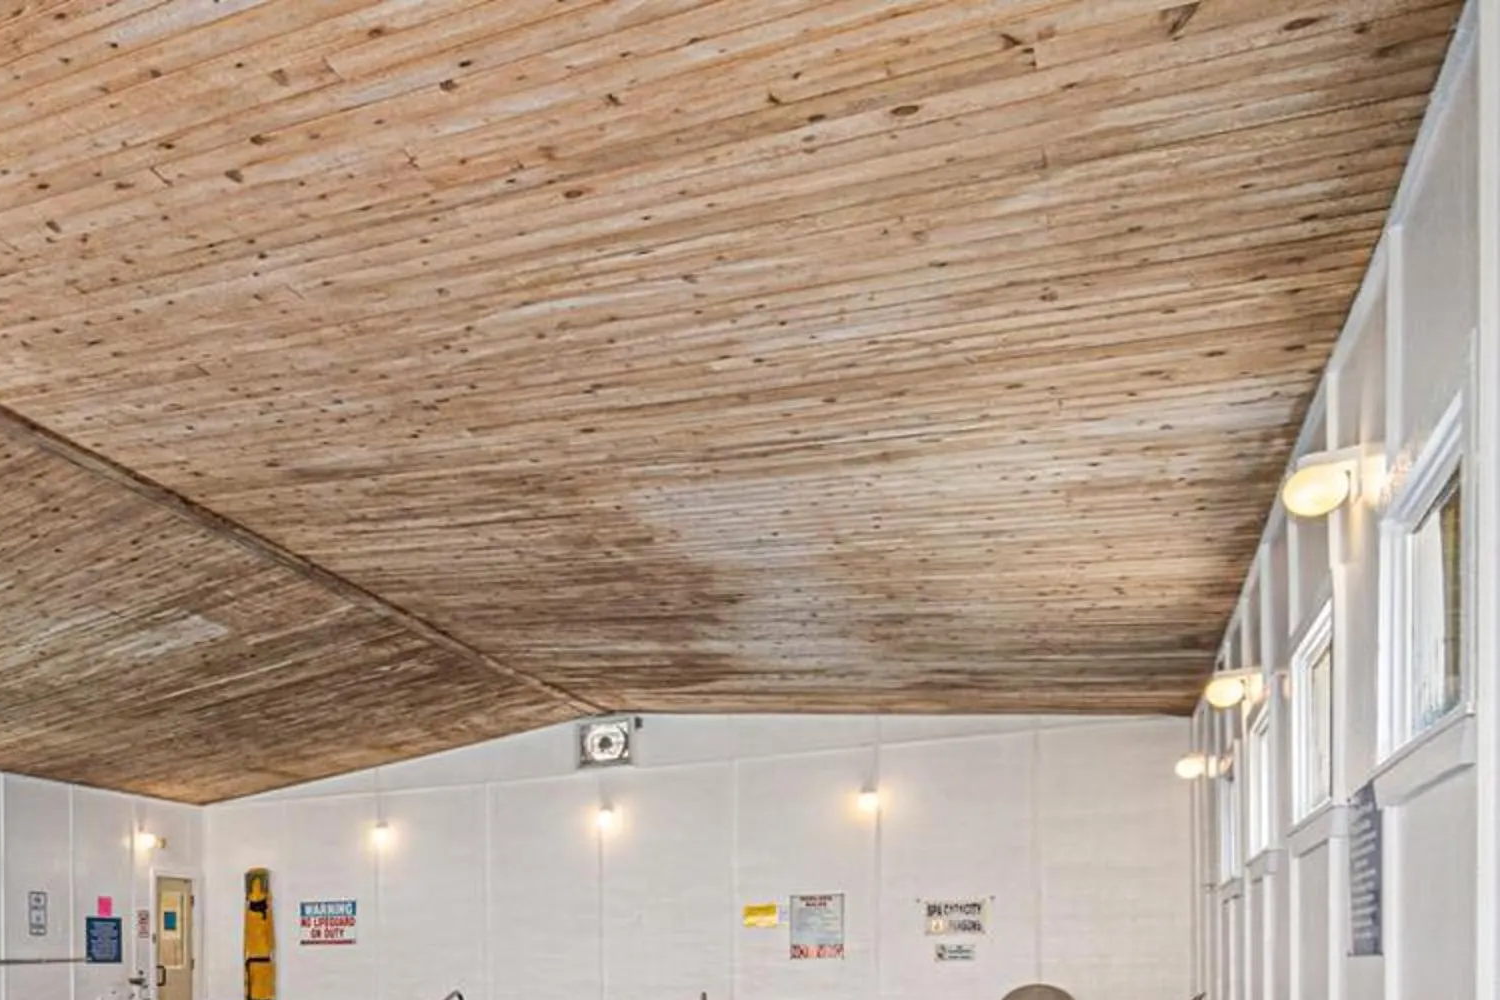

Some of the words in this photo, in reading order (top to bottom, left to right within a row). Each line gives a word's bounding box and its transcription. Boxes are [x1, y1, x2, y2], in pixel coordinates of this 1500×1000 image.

[303, 902, 354, 915] WARNING
[313, 916, 356, 928] LIFEGUARD
[311, 928, 321, 939] ON
[323, 928, 345, 939] DUTY
